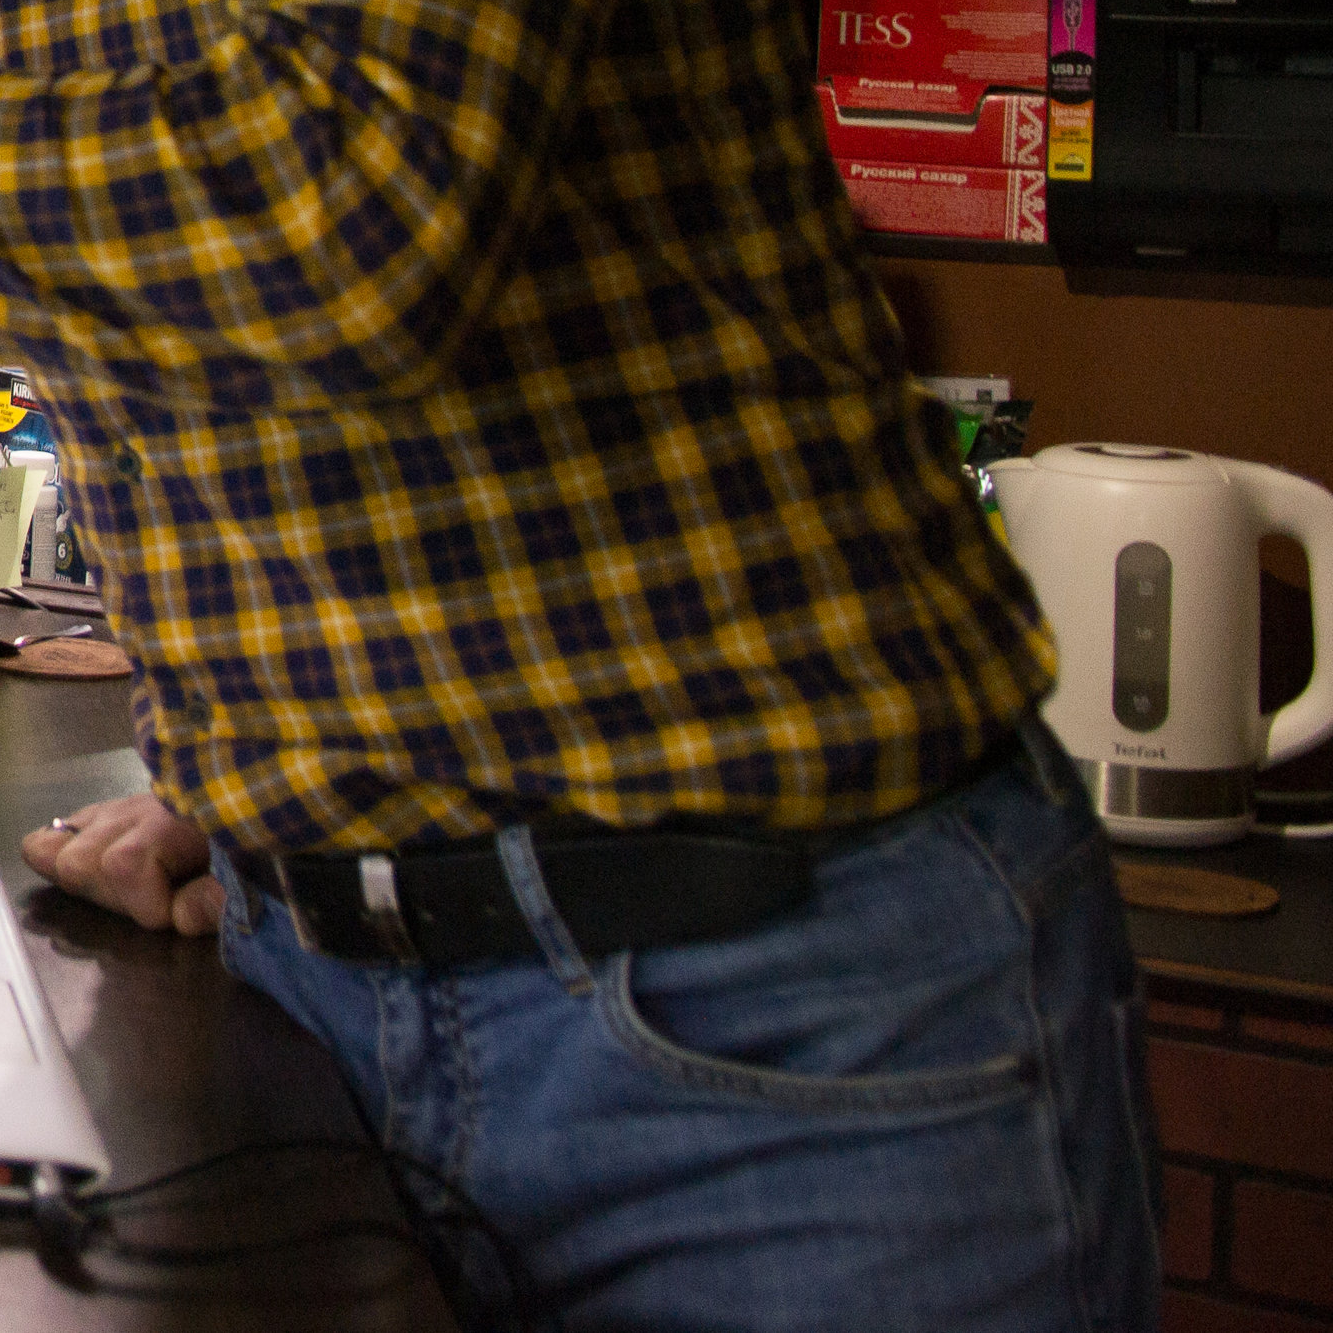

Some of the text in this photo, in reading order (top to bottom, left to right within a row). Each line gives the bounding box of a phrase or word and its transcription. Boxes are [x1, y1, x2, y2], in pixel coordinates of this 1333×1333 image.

[833, 10, 915, 49] TESS
[1052, 63, 1074, 76] USB
[1076, 64, 1092, 76] 2.0
[850, 163, 968, 185] Русский сахар
[57, 545, 67, 560] 6
